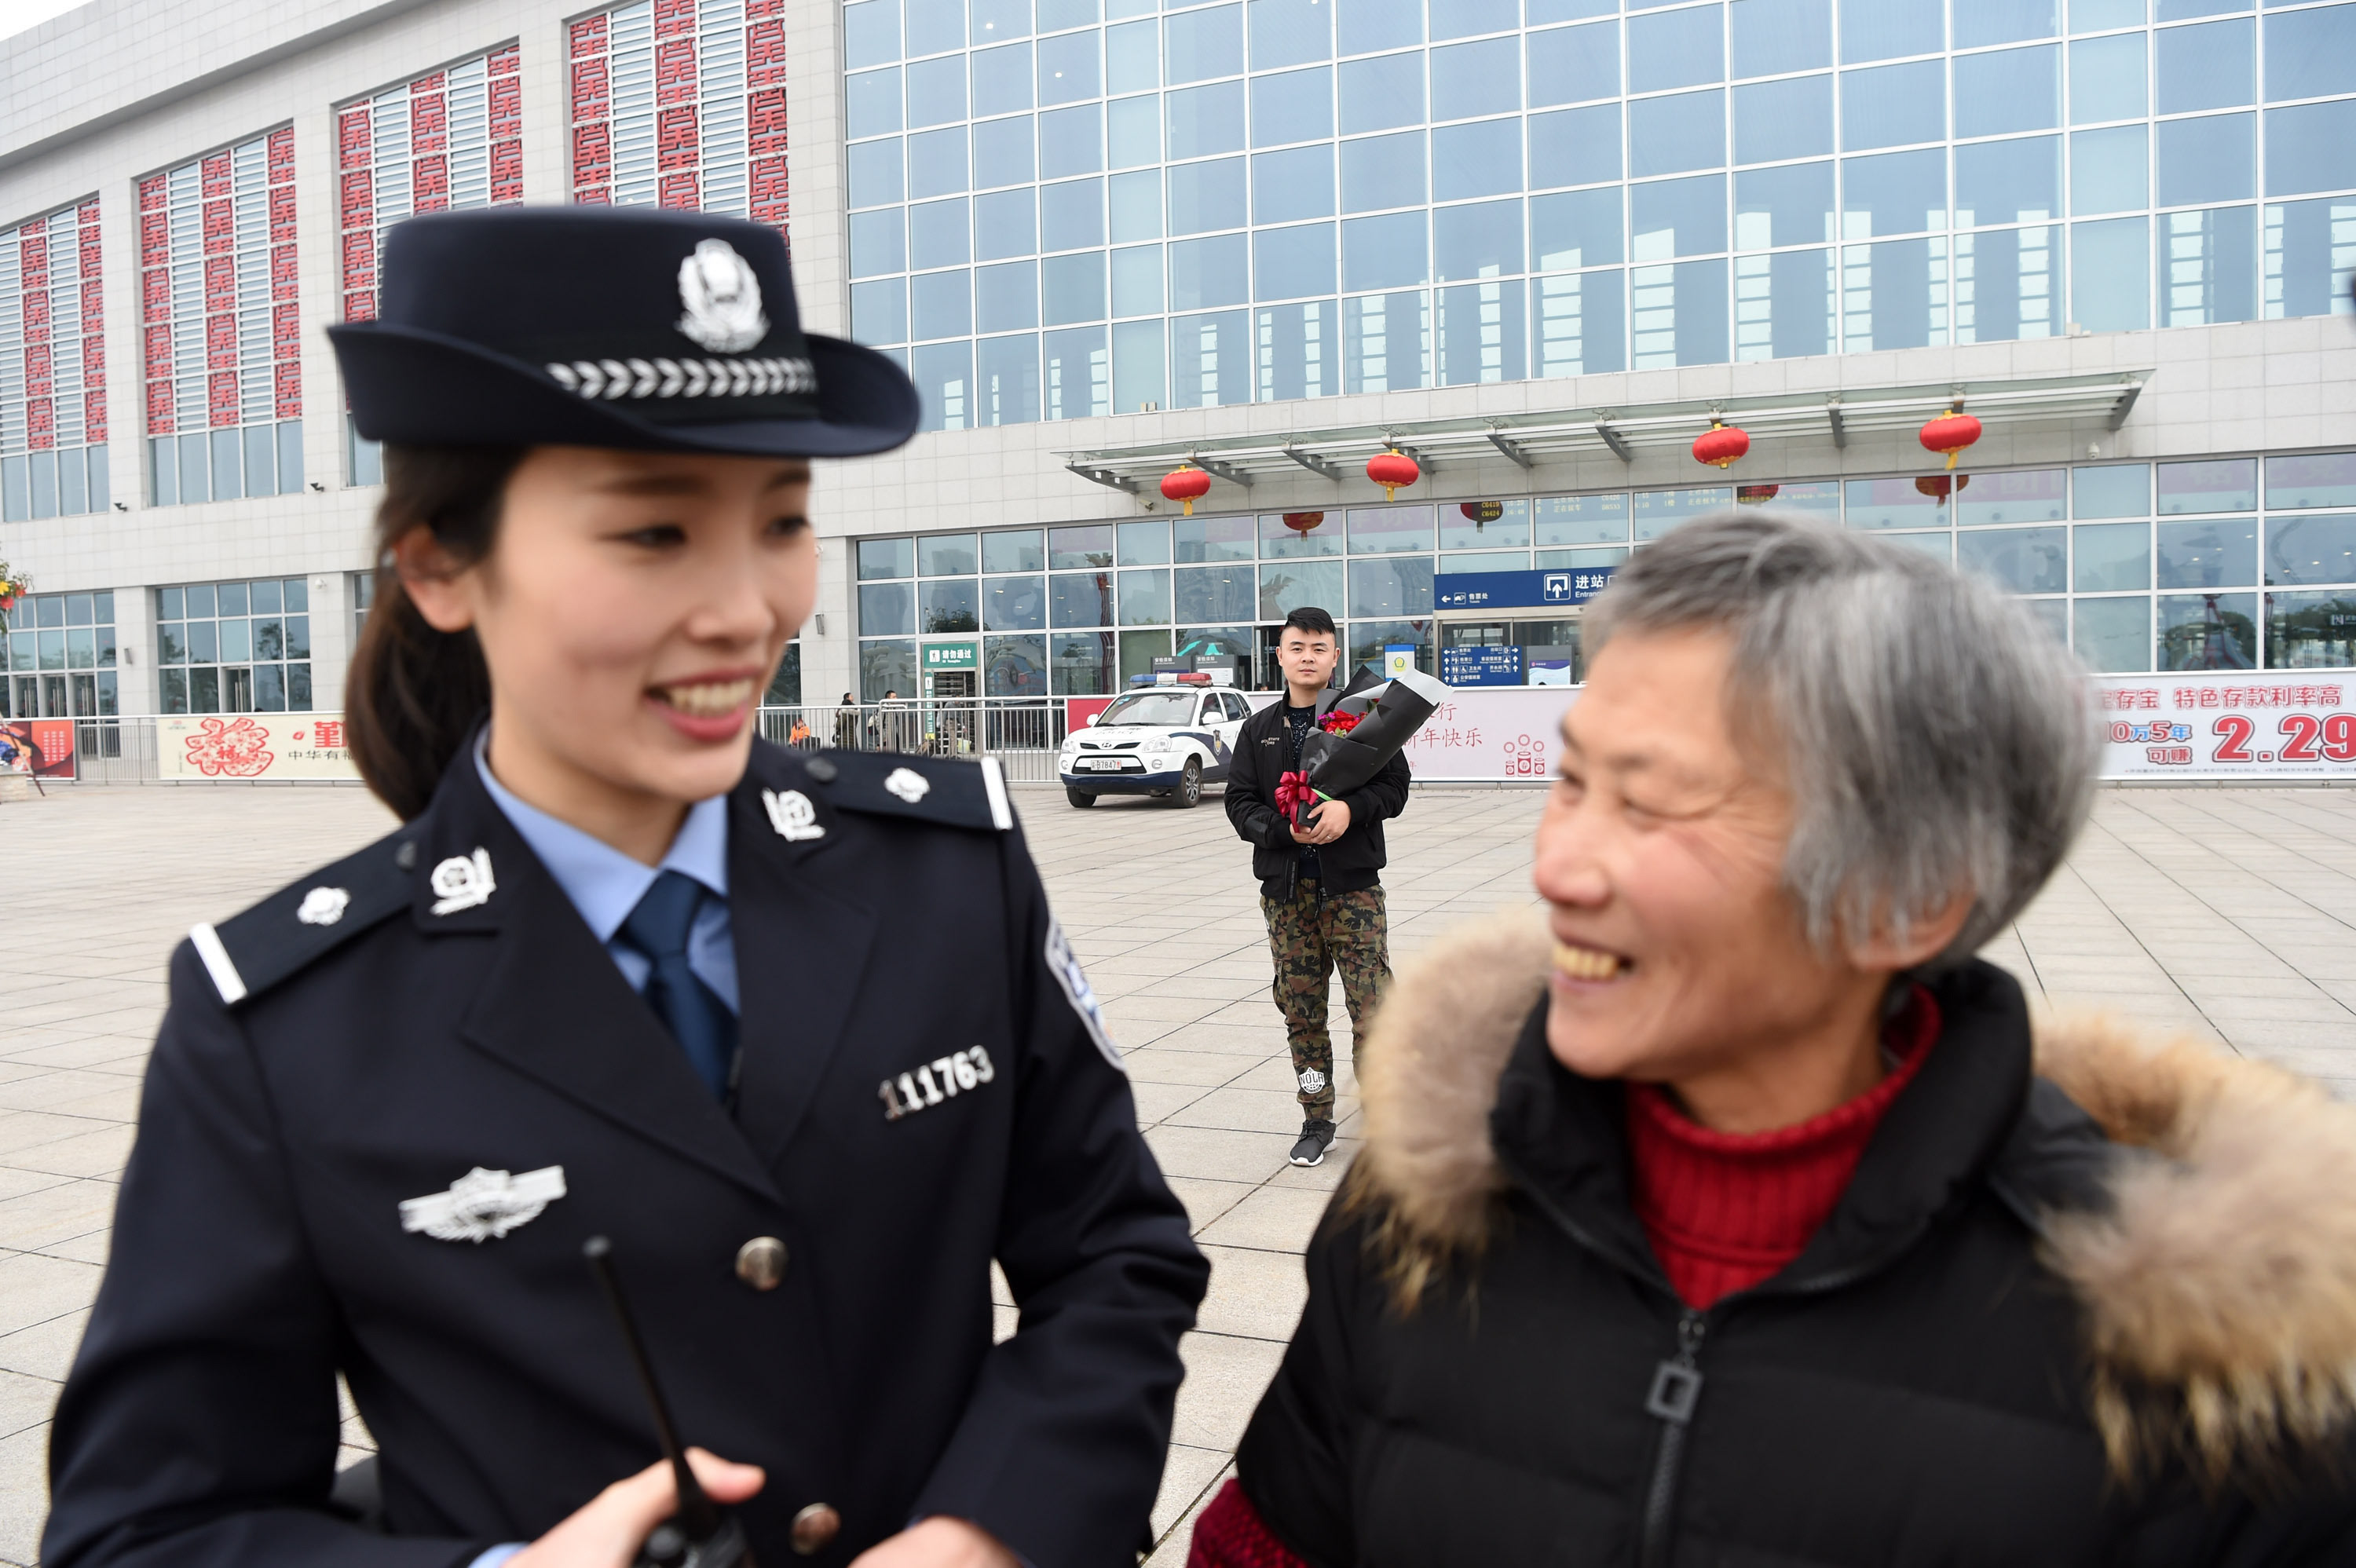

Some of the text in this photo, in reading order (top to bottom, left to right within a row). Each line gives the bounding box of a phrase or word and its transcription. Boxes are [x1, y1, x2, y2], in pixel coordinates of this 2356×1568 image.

[942, 649, 971, 659] 请勿通过
[2174, 684, 2343, 711] 特色存款利率高
[2146, 746, 2193, 765] 可赚
[878, 1045, 994, 1122] 111763
